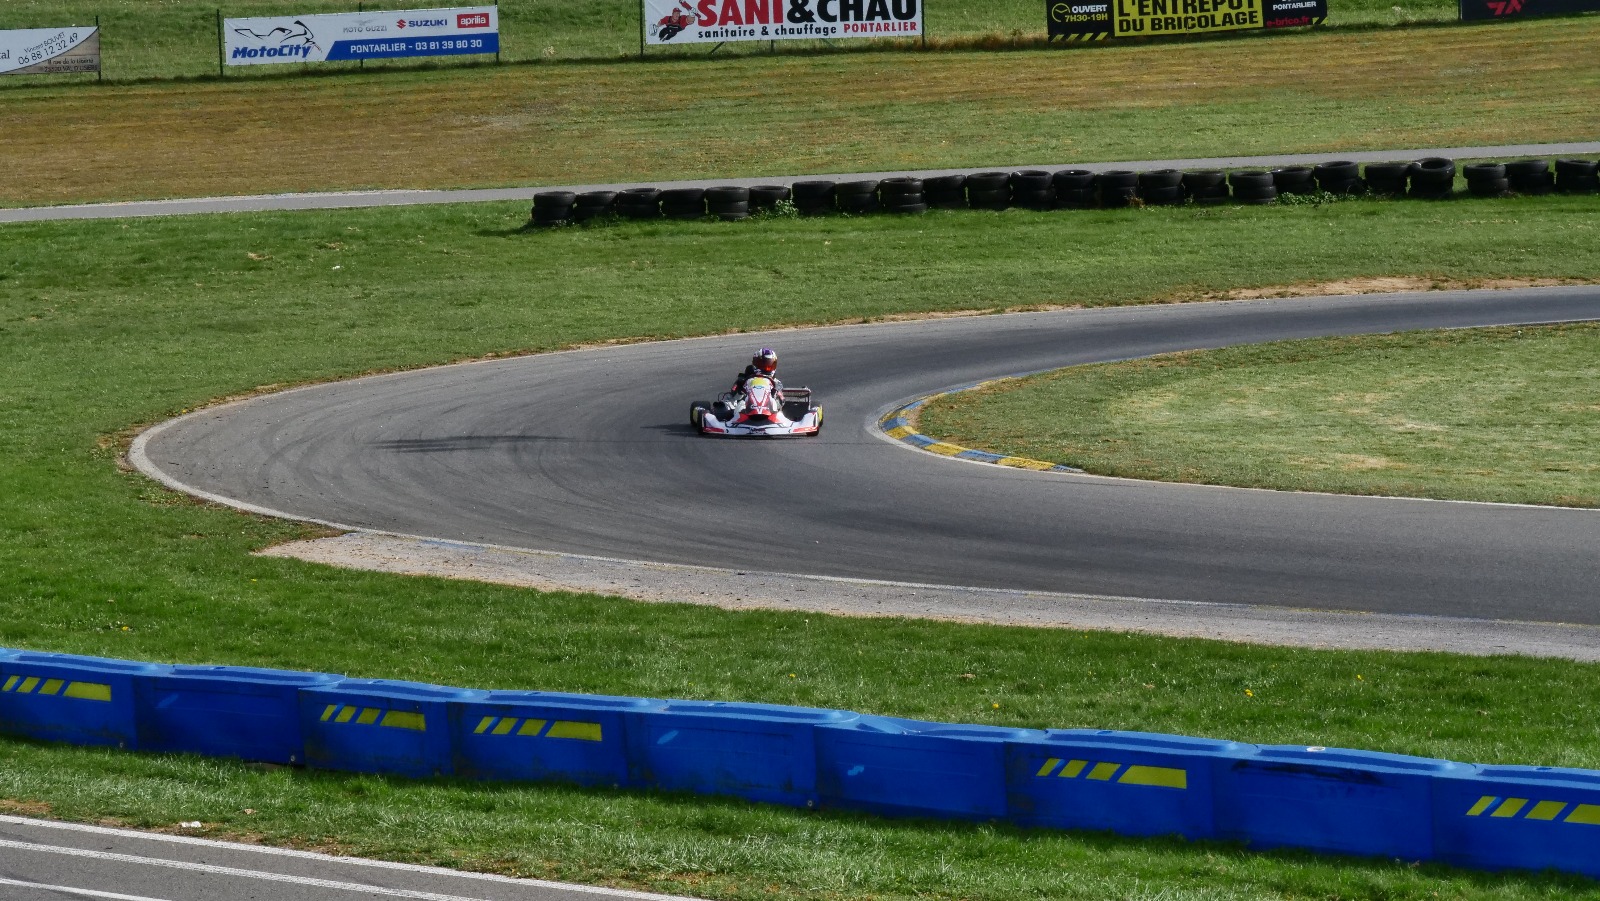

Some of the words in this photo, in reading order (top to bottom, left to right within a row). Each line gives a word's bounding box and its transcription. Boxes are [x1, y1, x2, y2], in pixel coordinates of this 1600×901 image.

[1071, 4, 1108, 14] OUVERT
[1272, 1, 1317, 11] PONTARLIER
[697, 0, 917, 27] SANI&CHAU
[1064, 13, 1108, 22] 7H30-19H
[408, 19, 448, 28] SUZUKI
[460, 15, 486, 26] aprilia
[1119, 18, 1145, 32] DU
[1150, 10, 1259, 31] BRICOLAGE
[1266, 16, 1310, 27] e-brico.fr
[698, 26, 755, 38] sanitaire
[761, 25, 769, 36] &
[775, 23, 837, 36] chauffage
[844, 21, 917, 33] PONTARLIER
[17, 55, 30, 65] 06
[31, 50, 43, 61] 88
[44, 45, 56, 56] 12
[56, 39, 68, 51] 32
[69, 32, 78, 44] 49
[232, 44, 312, 58] MotoCity
[350, 42, 406, 53] PONTARLIER
[415, 42, 427, 51] 03
[429, 41, 440, 50] 81
[441, 40, 454, 49] 39
[456, 39, 468, 48] 80
[470, 39, 482, 48] 30
[0, 49, 11, 60] al
